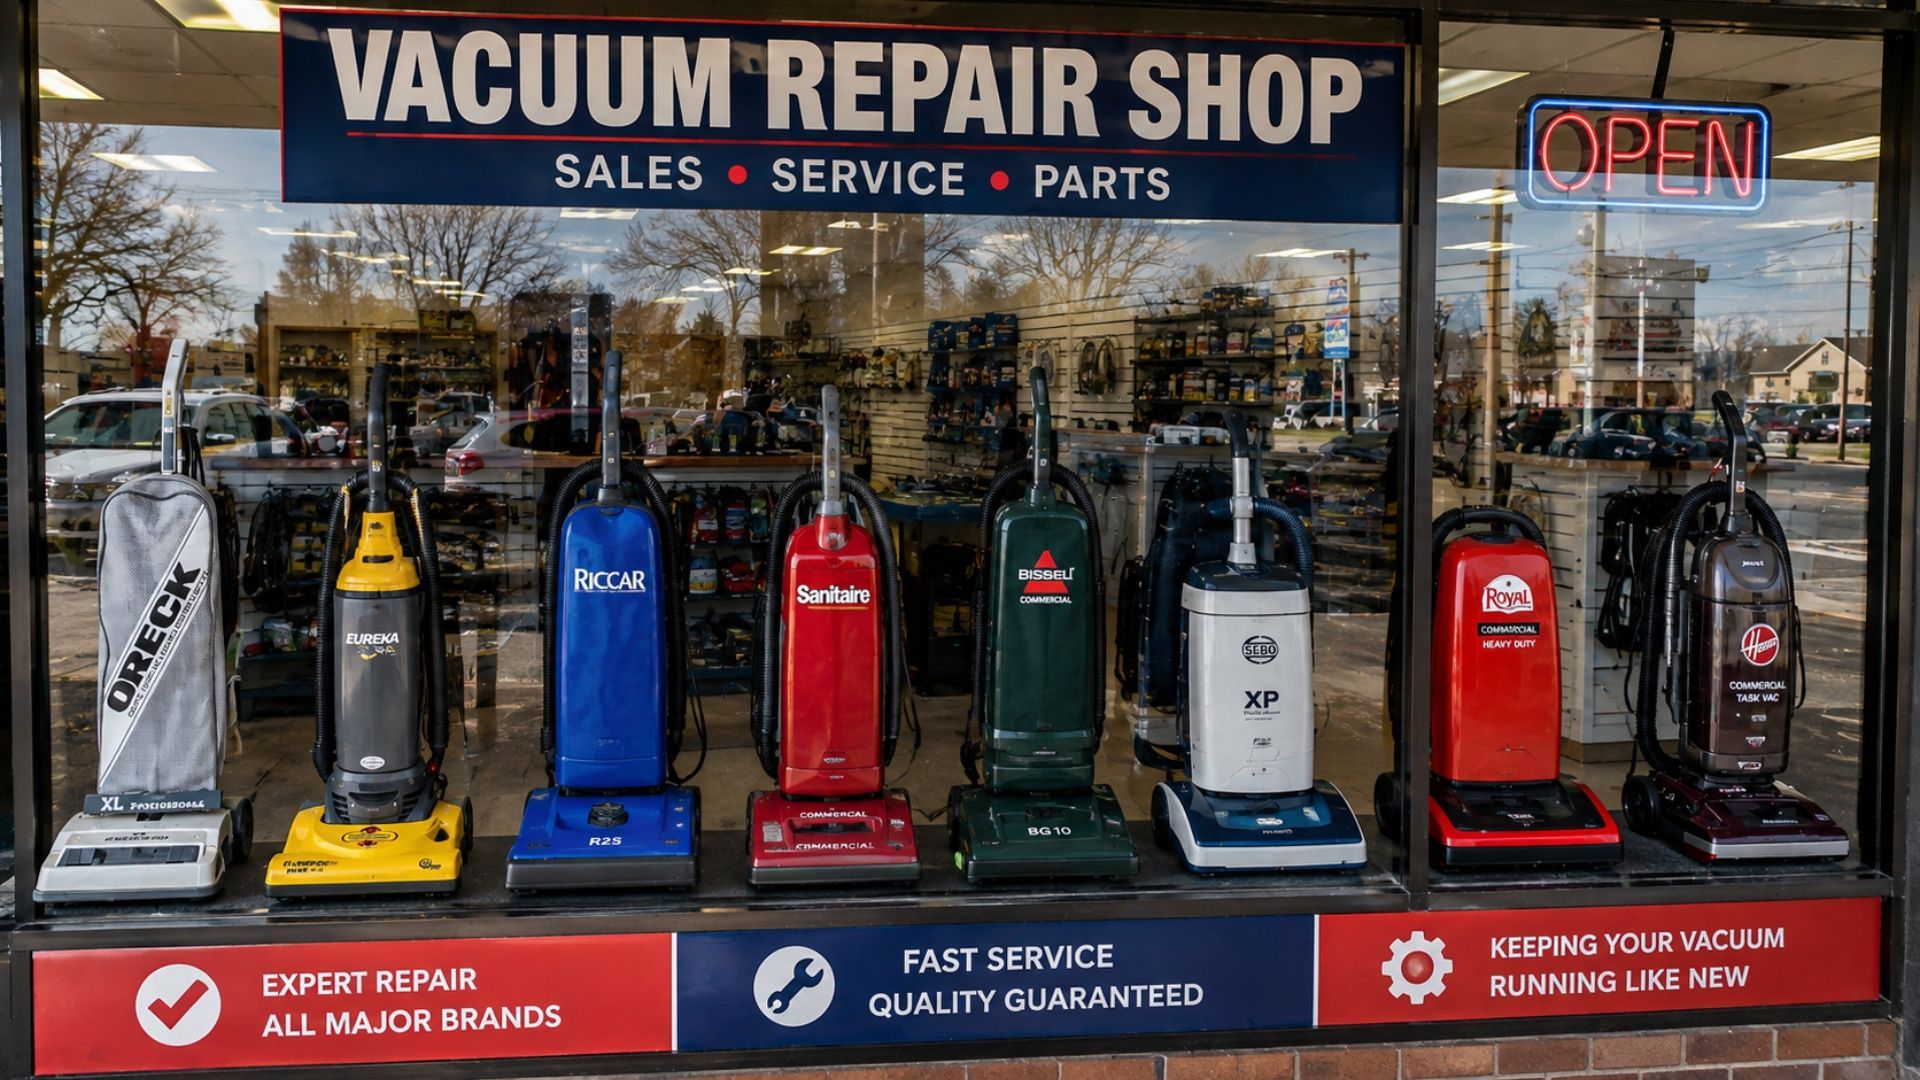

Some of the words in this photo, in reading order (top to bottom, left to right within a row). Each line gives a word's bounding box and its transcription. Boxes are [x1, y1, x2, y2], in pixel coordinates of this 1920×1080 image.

[327, 28, 732, 129] VACUUM
[767, 39, 1101, 137] REPAIR
[1128, 49, 1364, 145] SHOP
[1539, 112, 1754, 199] OPEN
[555, 153, 703, 191] SALES
[771, 157, 965, 196] SERVICE
[1035, 164, 1170, 201] PARTS
[1018, 567, 1075, 581] BISSELL
[796, 584, 871, 604] Sanitaire
[1019, 595, 1073, 604] COMMERCIAL
[107, 561, 202, 713] ORECK
[345, 632, 400, 645] EUREKA
[1482, 639, 1511, 649] HEAVY
[1514, 639, 1536, 649] DUTY
[1244, 644, 1277, 656] SEBO
[1244, 690, 1280, 709] XP
[1736, 693, 1760, 703] TASK
[1762, 692, 1781, 703] VAC
[100, 797, 124, 811] XL
[1027, 827, 1052, 836] BG
[1054, 826, 1072, 836] 10
[1491, 934, 1597, 958] KEEPING
[1605, 931, 1674, 955] YOUR
[1679, 927, 1785, 952] VACUUM
[904, 947, 979, 974] FAST
[987, 944, 1114, 971] SERVICE
[262, 970, 368, 997] EXPERT
[376, 967, 477, 993] REPAIR
[1490, 971, 1617, 997] RUNNING
[1625, 969, 1680, 992] LIKE
[1689, 965, 1750, 988] NEW
[868, 989, 997, 1018] QUALITY
[1004, 983, 1204, 1012] GUARANTEED
[261, 1012, 316, 1038] ALL
[325, 1008, 432, 1035] MAJOR
[441, 1004, 562, 1031] BRANDS
